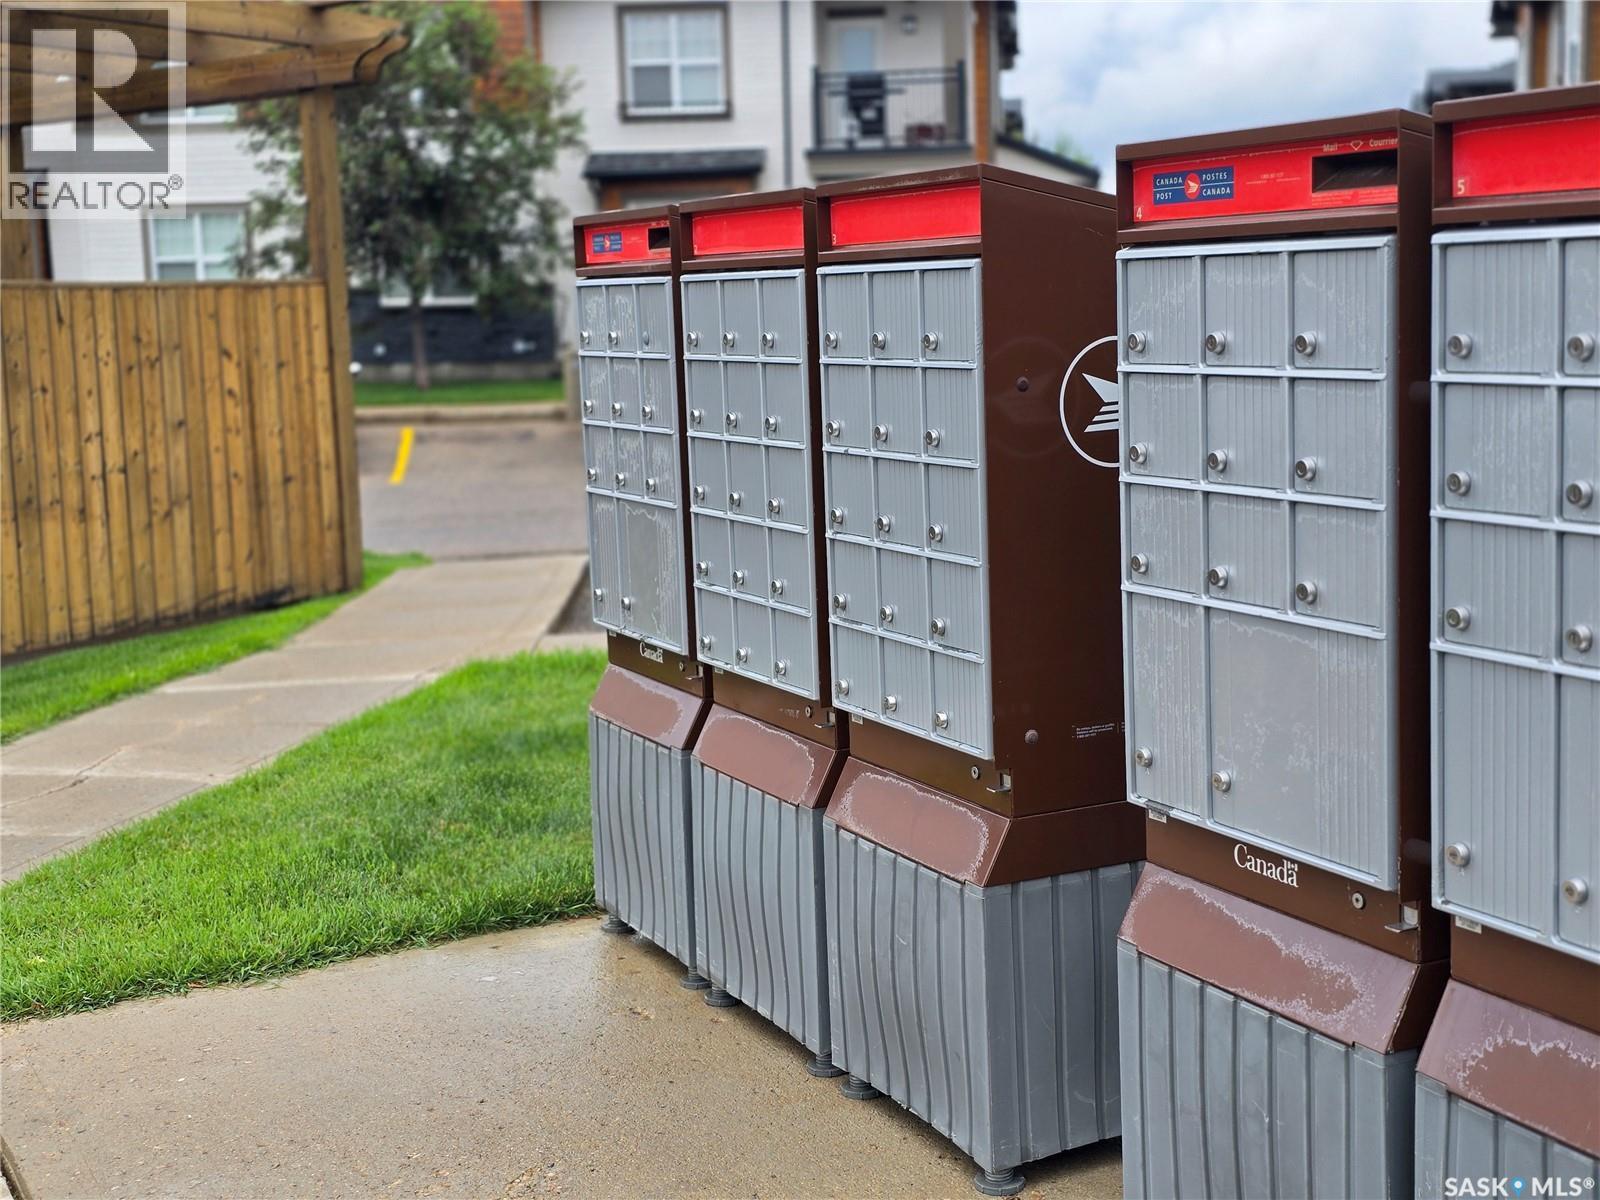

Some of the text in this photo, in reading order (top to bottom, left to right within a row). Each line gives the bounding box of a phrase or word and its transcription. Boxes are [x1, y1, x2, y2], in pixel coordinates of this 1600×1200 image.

[1322, 142, 1338, 152] Mail
[1156, 176, 1183, 186] CANADA
[1202, 171, 1228, 181] POSTES
[1202, 187, 1231, 196] CANADA
[1457, 179, 1465, 195] 5
[1156, 192, 1173, 200] POST
[1136, 207, 1142, 220] 4
[832, 233, 837, 245] 3
[640, 641, 664, 664] Canada
[1234, 843, 1299, 888] Canada
